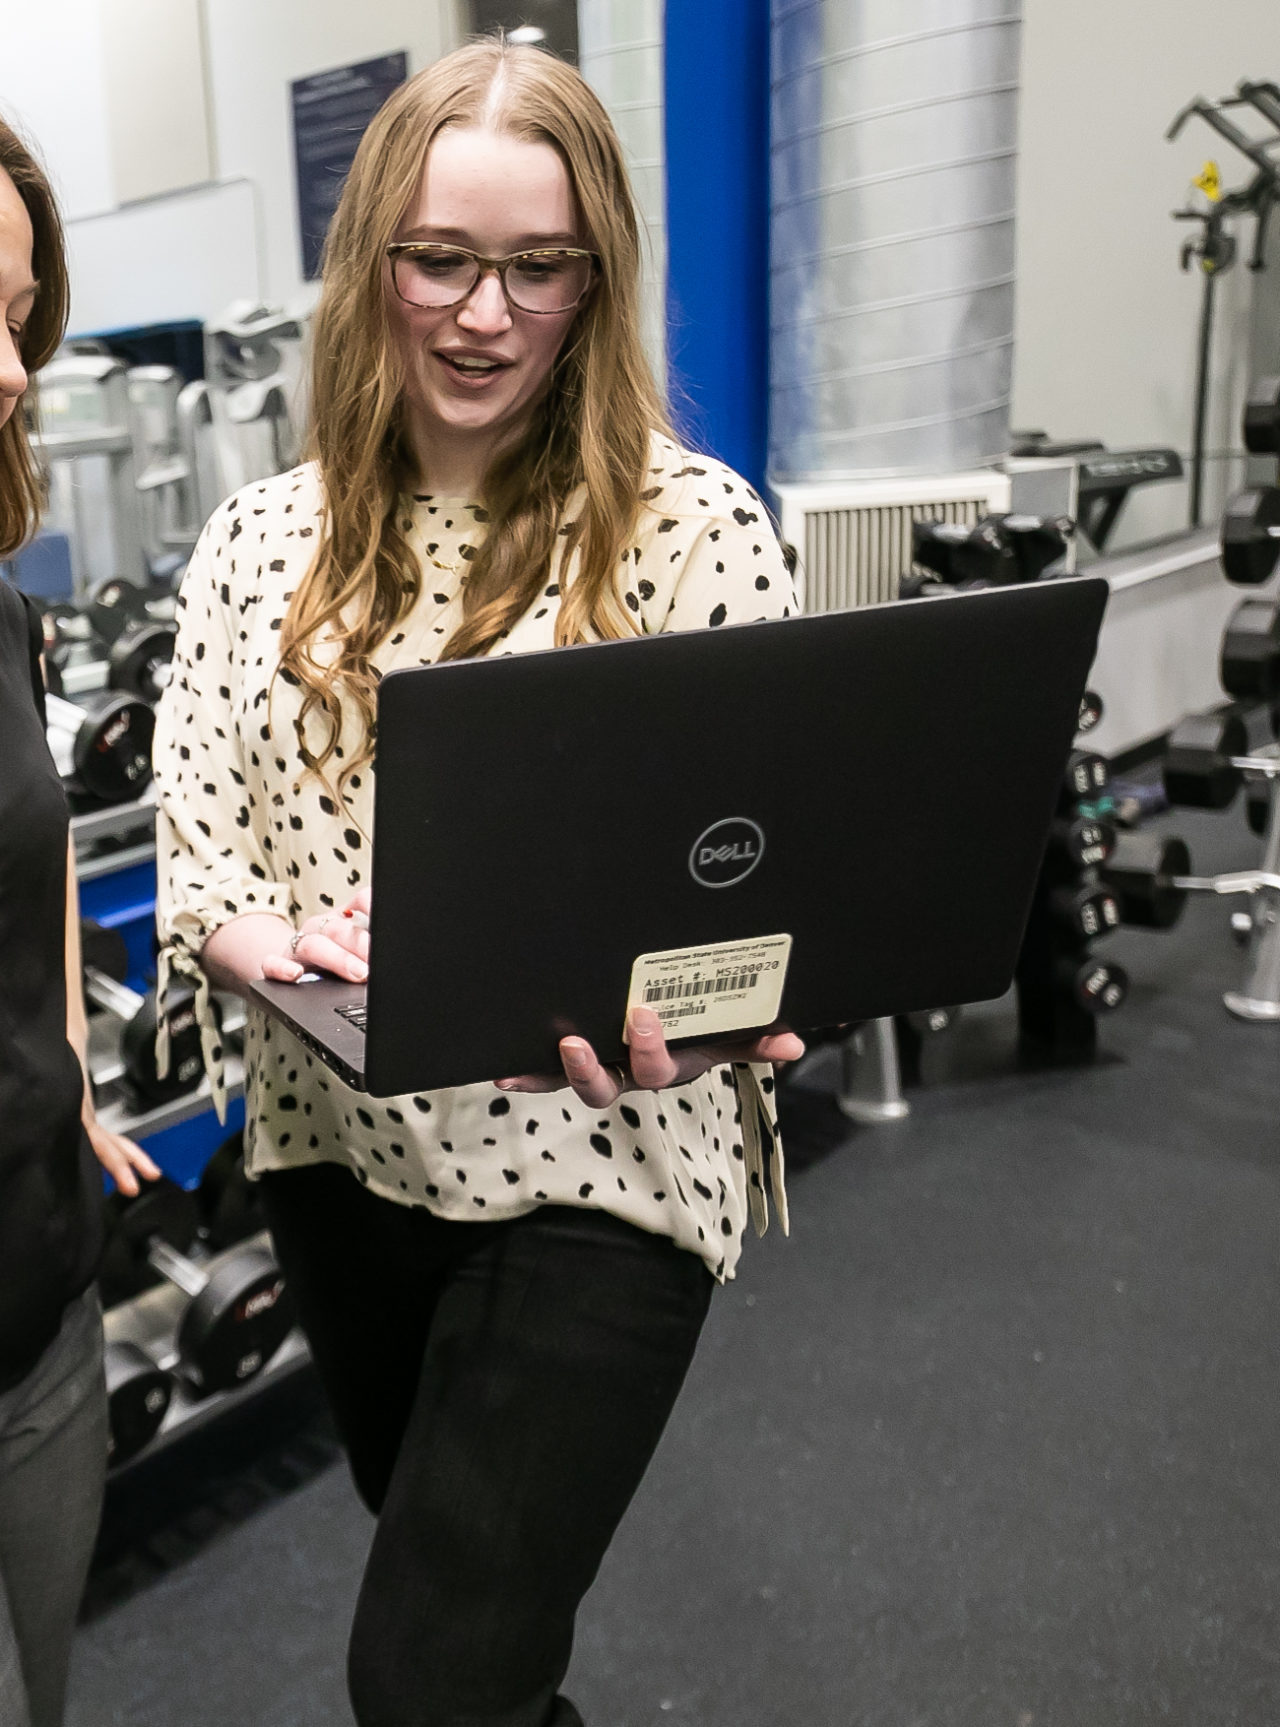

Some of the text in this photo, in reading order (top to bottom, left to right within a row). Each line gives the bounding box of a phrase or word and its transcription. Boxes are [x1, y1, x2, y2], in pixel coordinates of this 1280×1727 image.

[699, 841, 756, 866] DELL
[691, 951, 712, 959] State
[713, 946, 749, 955] University
[760, 941, 786, 949] Denver
[644, 974, 684, 988] Asset
[716, 960, 780, 978] MS200020
